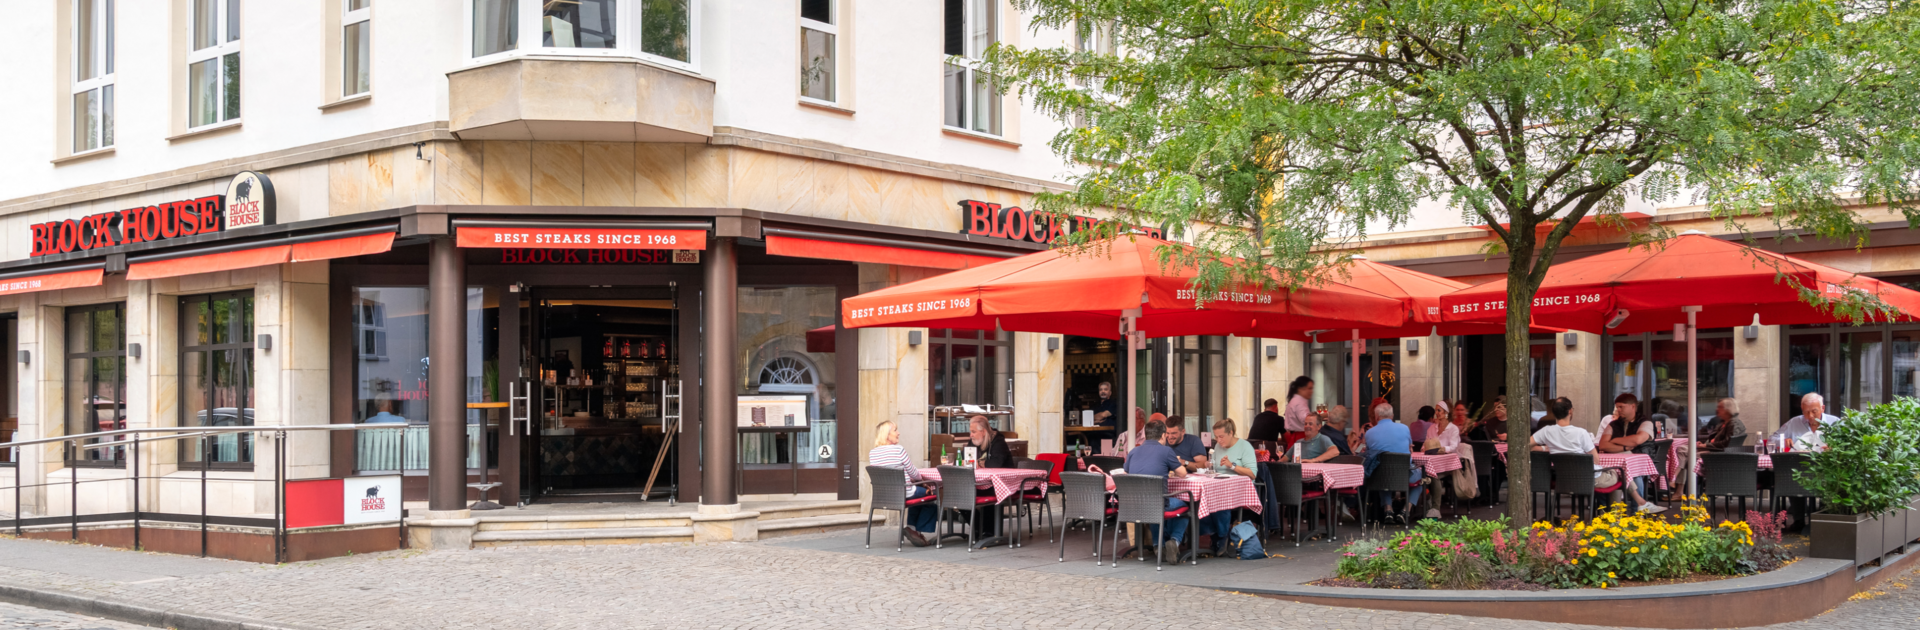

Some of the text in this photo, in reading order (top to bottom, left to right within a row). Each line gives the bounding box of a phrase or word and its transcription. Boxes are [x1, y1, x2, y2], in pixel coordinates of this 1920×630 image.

[229, 200, 259, 215] BLOCK
[30, 195, 219, 257] BLOCK HOUSE
[229, 212, 259, 227] HOUSE
[967, 200, 1069, 245] BLOCK
[494, 233, 677, 244] BEST STEAKS SINCE 1968
[501, 248, 667, 263] BLOCK HOUSE
[10, 281, 28, 290] SINCE
[1176, 289, 1195, 300] BEST
[1231, 292, 1253, 303] SINCE
[851, 298, 970, 319] BEST STEAKS SINCE 1968
[1452, 293, 1600, 314] BEST STE SINCE 1968
[398, 390, 429, 400] HOUS
[820, 446, 830, 456] A
[361, 497, 385, 505] BLOCK
[361, 503, 385, 511] HOUSE
